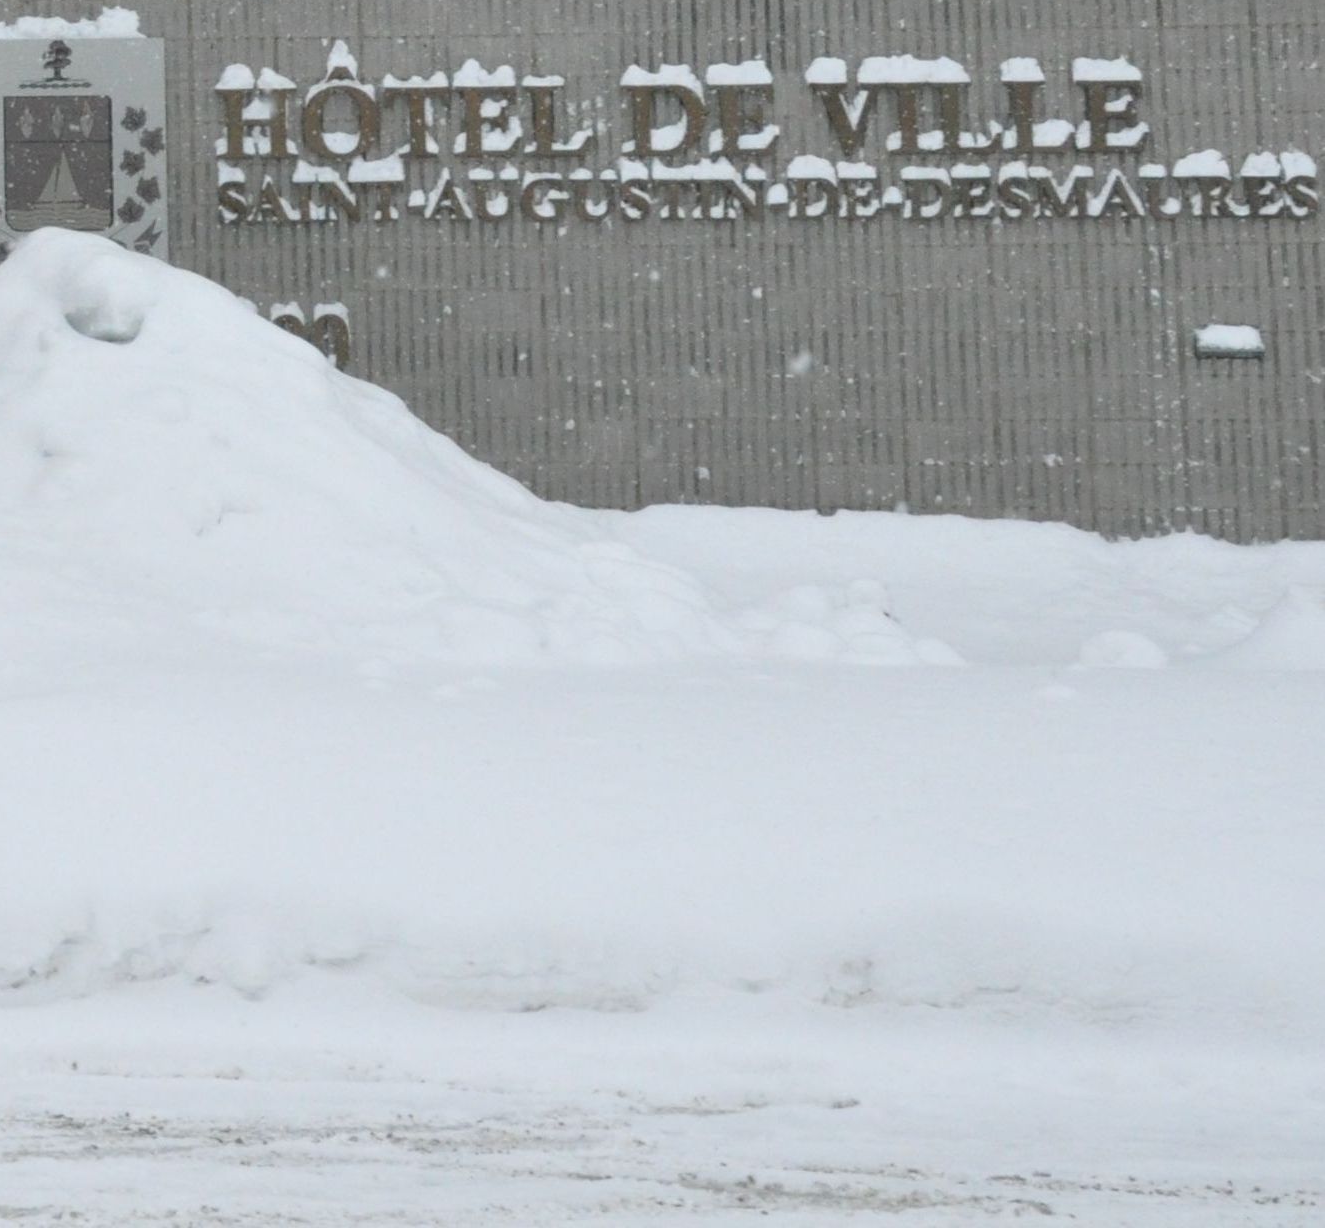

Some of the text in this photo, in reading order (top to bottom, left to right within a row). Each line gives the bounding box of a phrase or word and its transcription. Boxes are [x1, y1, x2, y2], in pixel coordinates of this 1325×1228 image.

[215, 63, 1150, 159] HÔTEL DE VILLE
